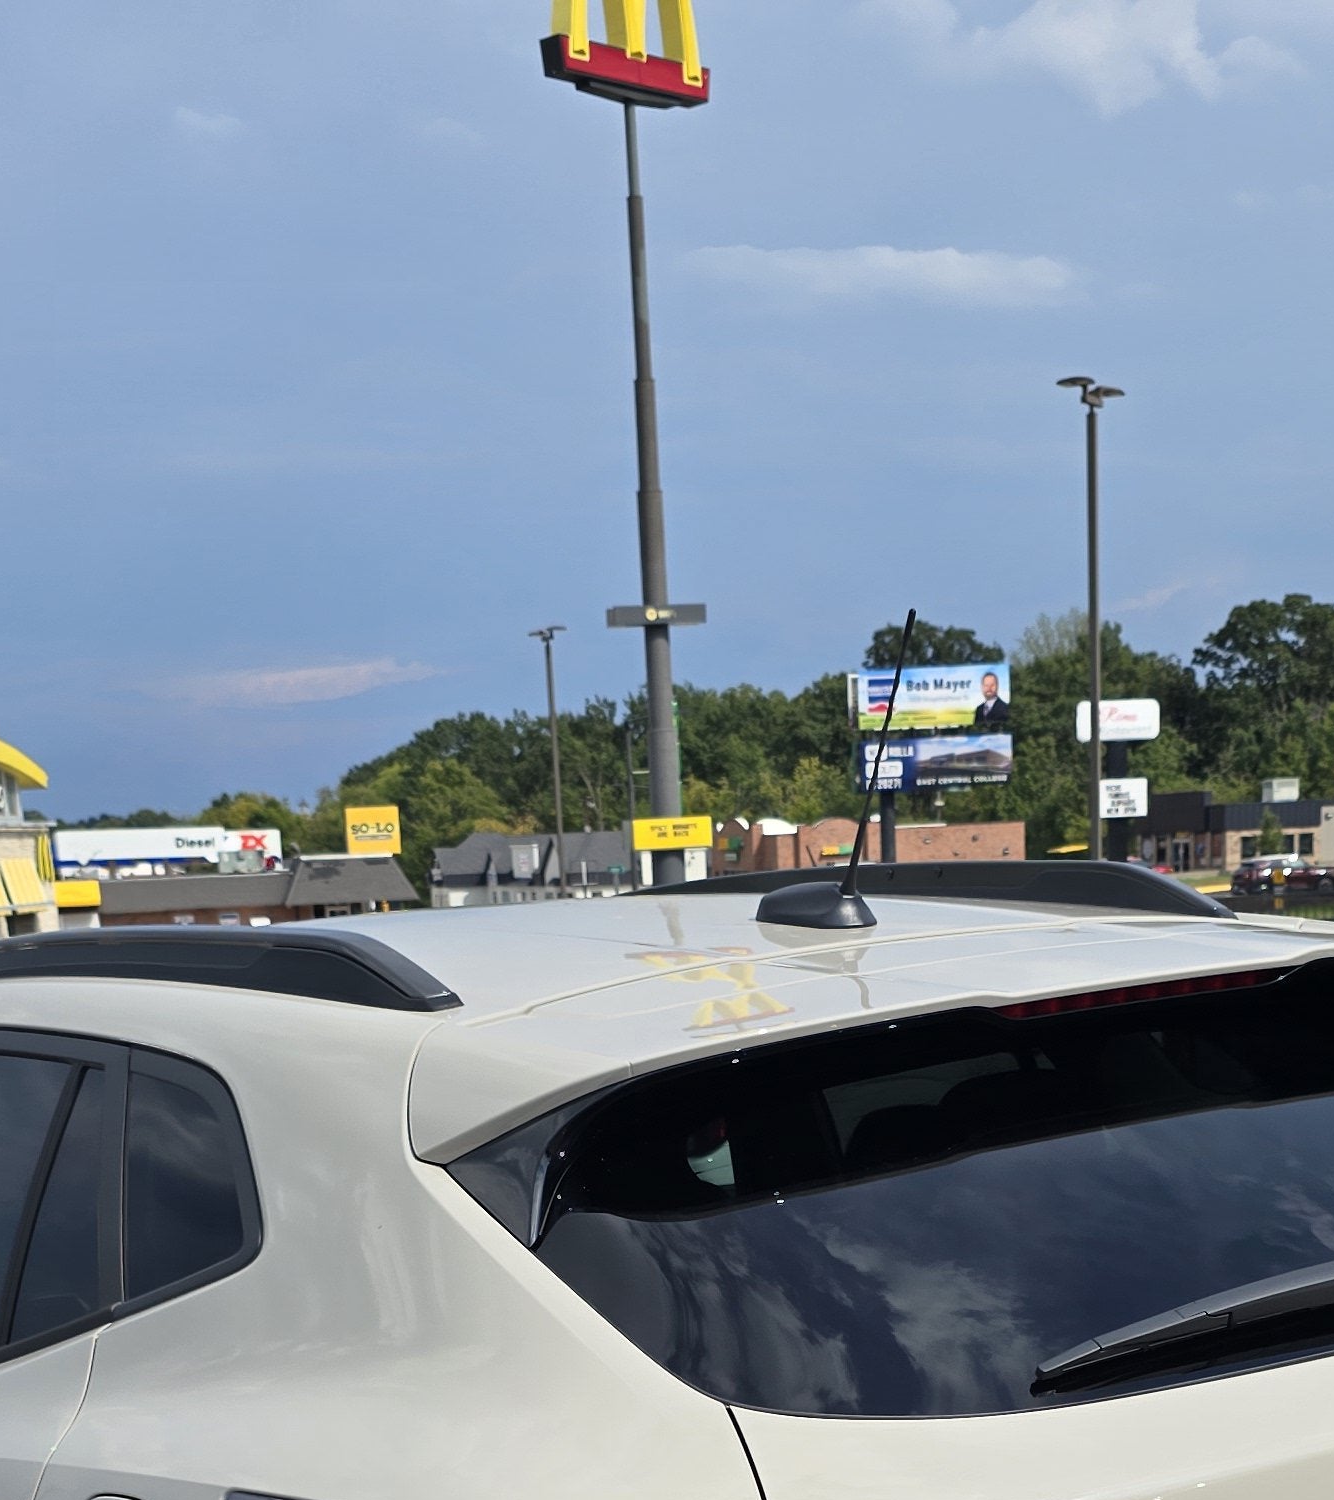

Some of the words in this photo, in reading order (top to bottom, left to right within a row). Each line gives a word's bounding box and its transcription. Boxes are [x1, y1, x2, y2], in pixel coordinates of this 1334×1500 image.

[906, 679, 930, 693] Bob
[934, 677, 972, 693] Mayer
[175, 836, 215, 849] Diesel
